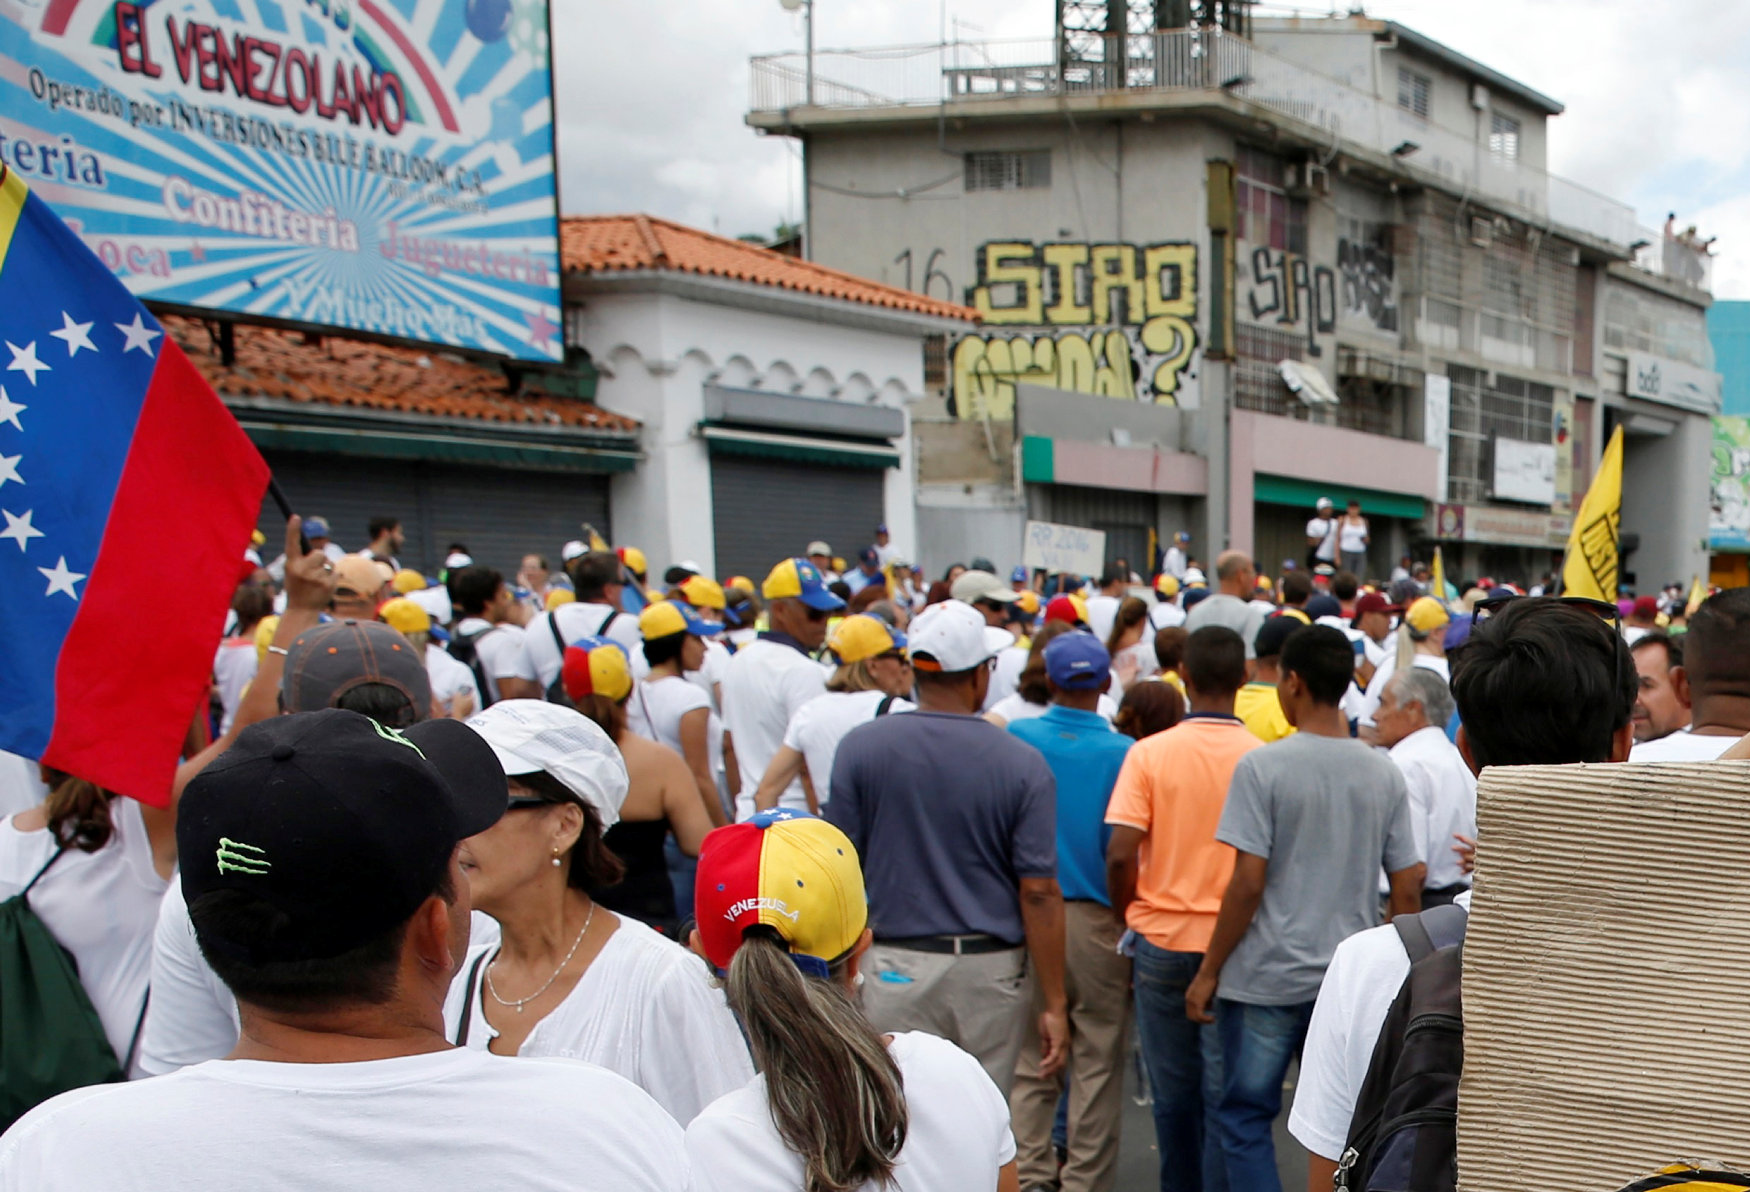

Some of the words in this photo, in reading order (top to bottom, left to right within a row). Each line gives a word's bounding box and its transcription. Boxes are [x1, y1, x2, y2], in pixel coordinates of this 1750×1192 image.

[29, 66, 123, 119] Operado
[129, 99, 165, 128] por
[168, 99, 308, 159] INVERSIONES
[116, 1, 162, 78] EL
[167, 13, 406, 136] VENEZOLANO
[723, 897, 799, 922] VENEZUELA
